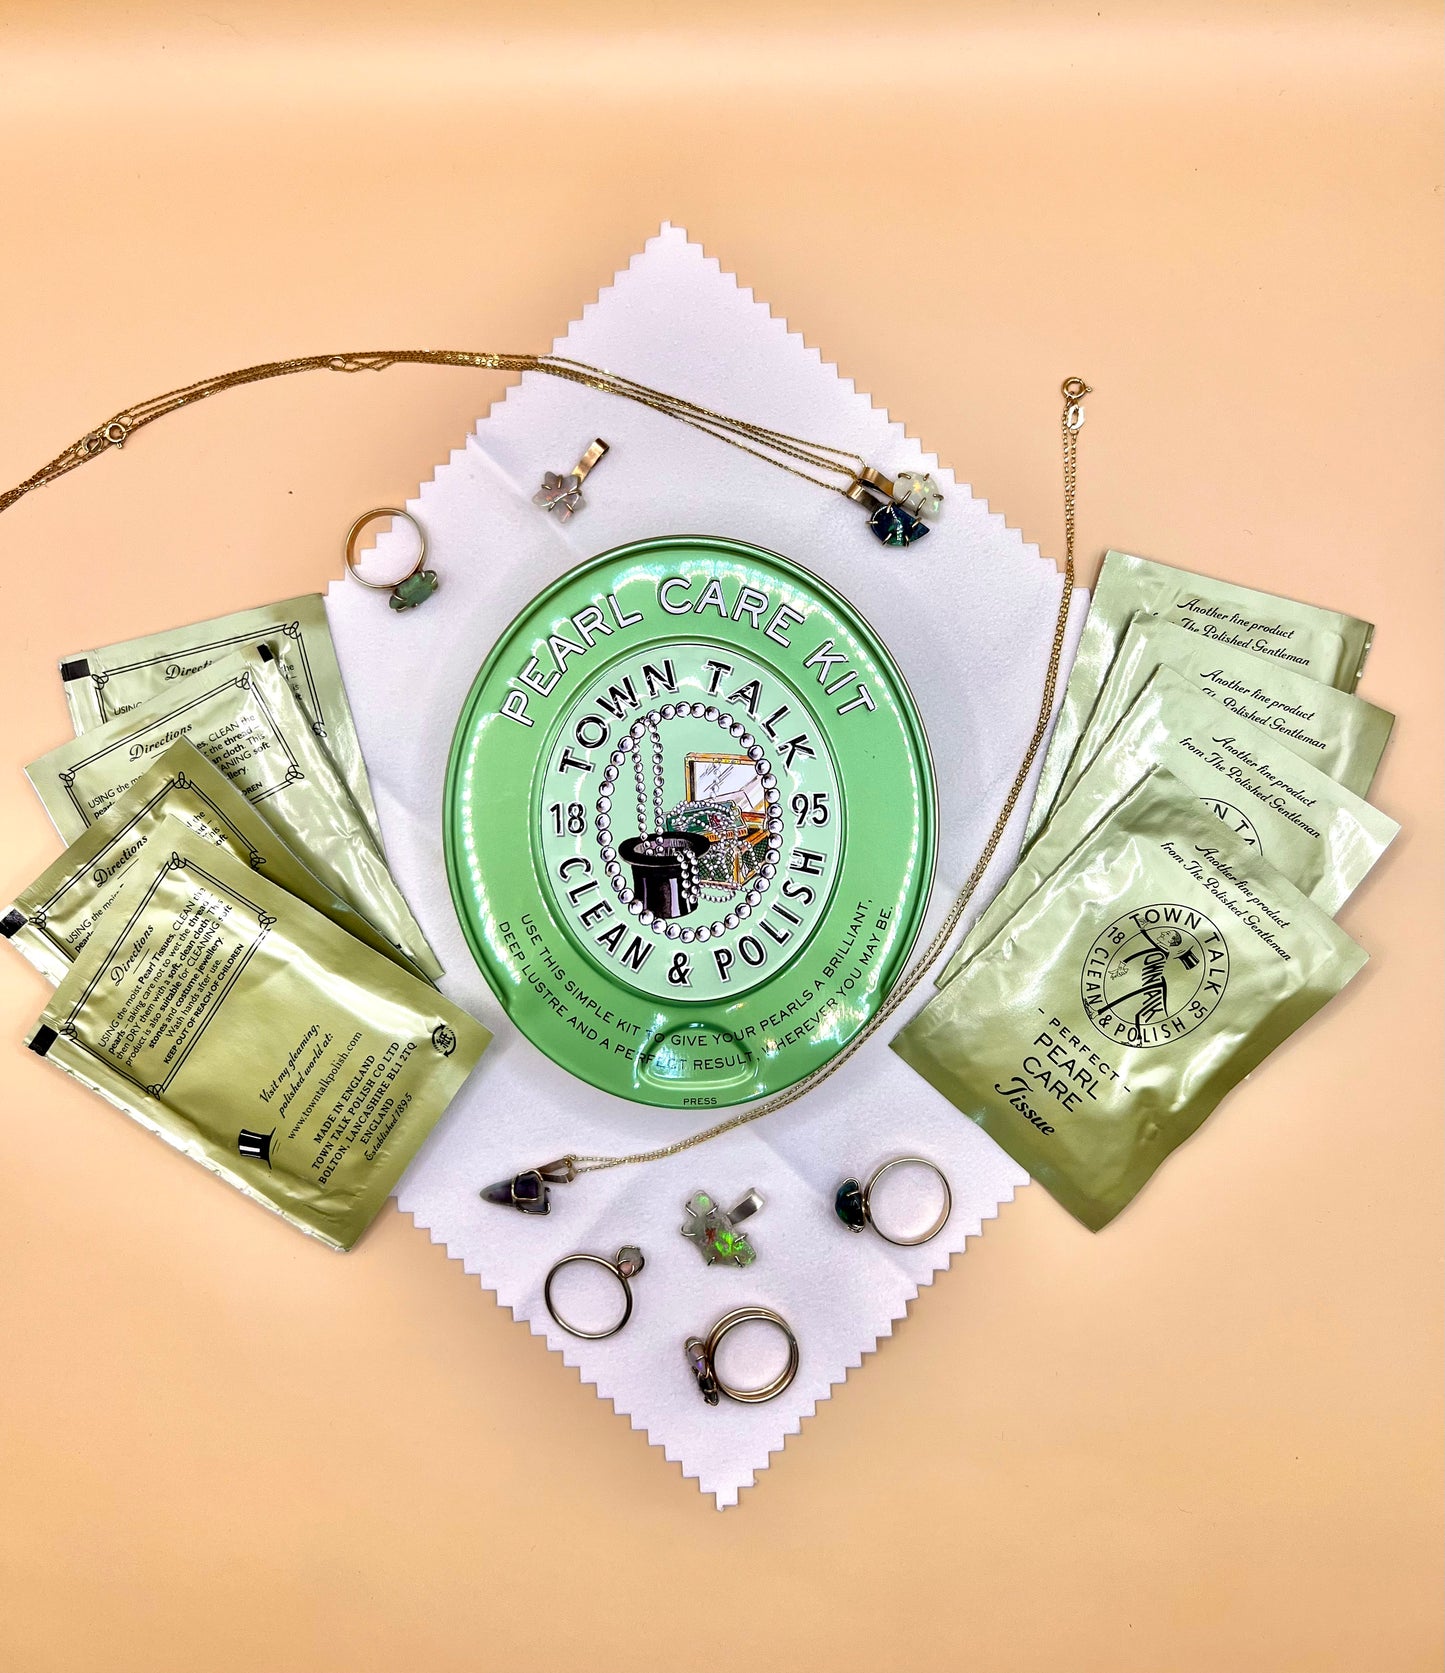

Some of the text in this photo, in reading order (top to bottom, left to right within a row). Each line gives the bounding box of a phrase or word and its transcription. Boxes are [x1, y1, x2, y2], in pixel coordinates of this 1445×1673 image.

[501, 577, 878, 727] PEARL CARE KIT
[1177, 598, 1295, 639] Another fine product
[1202, 624, 1254, 649] Polished
[1251, 638, 1310, 666] Gentleman
[558, 658, 818, 777] TOWN TALK
[1199, 669, 1251, 694] Another
[1250, 688, 1271, 704] fine
[1266, 698, 1316, 721] product
[1223, 697, 1327, 750] Polished Gentleman
[87, 788, 116, 809] USING
[116, 783, 130, 794] the
[208, 723, 240, 743] CLEAN
[129, 723, 193, 763] Directions
[208, 743, 224, 755] the
[222, 743, 247, 759] cloth.
[245, 733, 266, 745] This
[252, 741, 271, 755] soft
[1211, 736, 1317, 808] Another fine product
[549, 802, 587, 836] 18
[790, 793, 831, 828] 95
[1179, 737, 1205, 758] from
[1204, 752, 1226, 772] The
[1225, 766, 1273, 803] Polished
[1268, 794, 1321, 839] Gentleman
[93, 824, 148, 889] Directions
[1194, 844, 1291, 929] Another fine product
[65, 909, 104, 944] USING the
[556, 849, 827, 987] CLEAN & POLISH
[1107, 926, 1126, 945] 18
[1160, 842, 1291, 961] from The Polished Gentleman
[97, 1019, 120, 1048] USING
[116, 1007, 128, 1020] the
[125, 984, 143, 1007] moist
[137, 961, 156, 985] Pearl
[151, 933, 177, 962] Tissues,
[172, 900, 196, 931] CLEAN
[110, 924, 154, 987] Directions
[114, 1042, 131, 1060] then
[125, 1021, 142, 1043] DRY
[139, 1003, 156, 1023] them
[152, 985, 167, 1002] with
[167, 962, 184, 980] soft,
[179, 939, 196, 962] clean
[193, 918, 212, 940] cloth.
[207, 899, 224, 915] Ths
[499, 920, 526, 964] DEEP
[521, 961, 570, 1018] LUSTRE
[567, 1014, 600, 1042] AND
[600, 1037, 611, 1051] A
[693, 1051, 761, 1072] RESULT,
[837, 967, 864, 1002] YOU
[858, 934, 883, 969] MAY
[877, 904, 894, 933] BE.
[521, 913, 544, 947] USE
[539, 946, 566, 982] THIS
[565, 978, 614, 1025] SIMPLE
[616, 1016, 642, 1039] KIT
[670, 1035, 708, 1048] GIVE
[712, 1024, 757, 1047] YOUR
[759, 988, 814, 1030] PEARLS
[814, 979, 825, 990] A
[823, 897, 874, 980] BRILLIANT,
[1128, 906, 1226, 996] TOWN TALK
[106, 1029, 128, 1056] pearls
[127, 1000, 147, 1024] taking
[142, 983, 156, 1000] care
[152, 968, 166, 983] not
[162, 958, 171, 968] to
[168, 941, 183, 957] wet
[178, 928, 191, 942] the
[125, 1036, 147, 1068] product
[142, 1028, 152, 1036] is
[149, 1012, 162, 1029] also
[159, 981, 183, 1013] suitable
[177, 967, 190, 981] for
[186, 920, 221, 967] CLEANING
[148, 937, 225, 1049] stones and costume jewellery.
[163, 943, 245, 1065] KEEP OUT OF REACH OF CHILDREN
[165, 959, 223, 1038] Wash hands after use.
[1085, 947, 1187, 1043] CLEAN & POLISH
[1187, 1000, 1209, 1019] 95
[259, 1024, 321, 1103] Visit my gleaming,
[279, 1033, 334, 1119] polished world at:
[287, 1031, 363, 1139] www.towntalkpolish.com
[1022, 1056, 1083, 1113] CARE
[1033, 1031, 1099, 1101] PEARL
[1048, 1017, 1120, 1081] PERFECT
[311, 1042, 400, 1170] TOWN TALK POLISH CO LTD
[313, 1055, 376, 1144] MADE IN ENGLAND
[317, 1042, 418, 1185] BOLTON, LANCASHIRE BL1 2TQ
[359, 1098, 395, 1145] ENGLAND
[363, 1091, 413, 1161] Established 1895
[683, 1097, 718, 1106] PRESS
[994, 1076, 1055, 1137] Tissue
